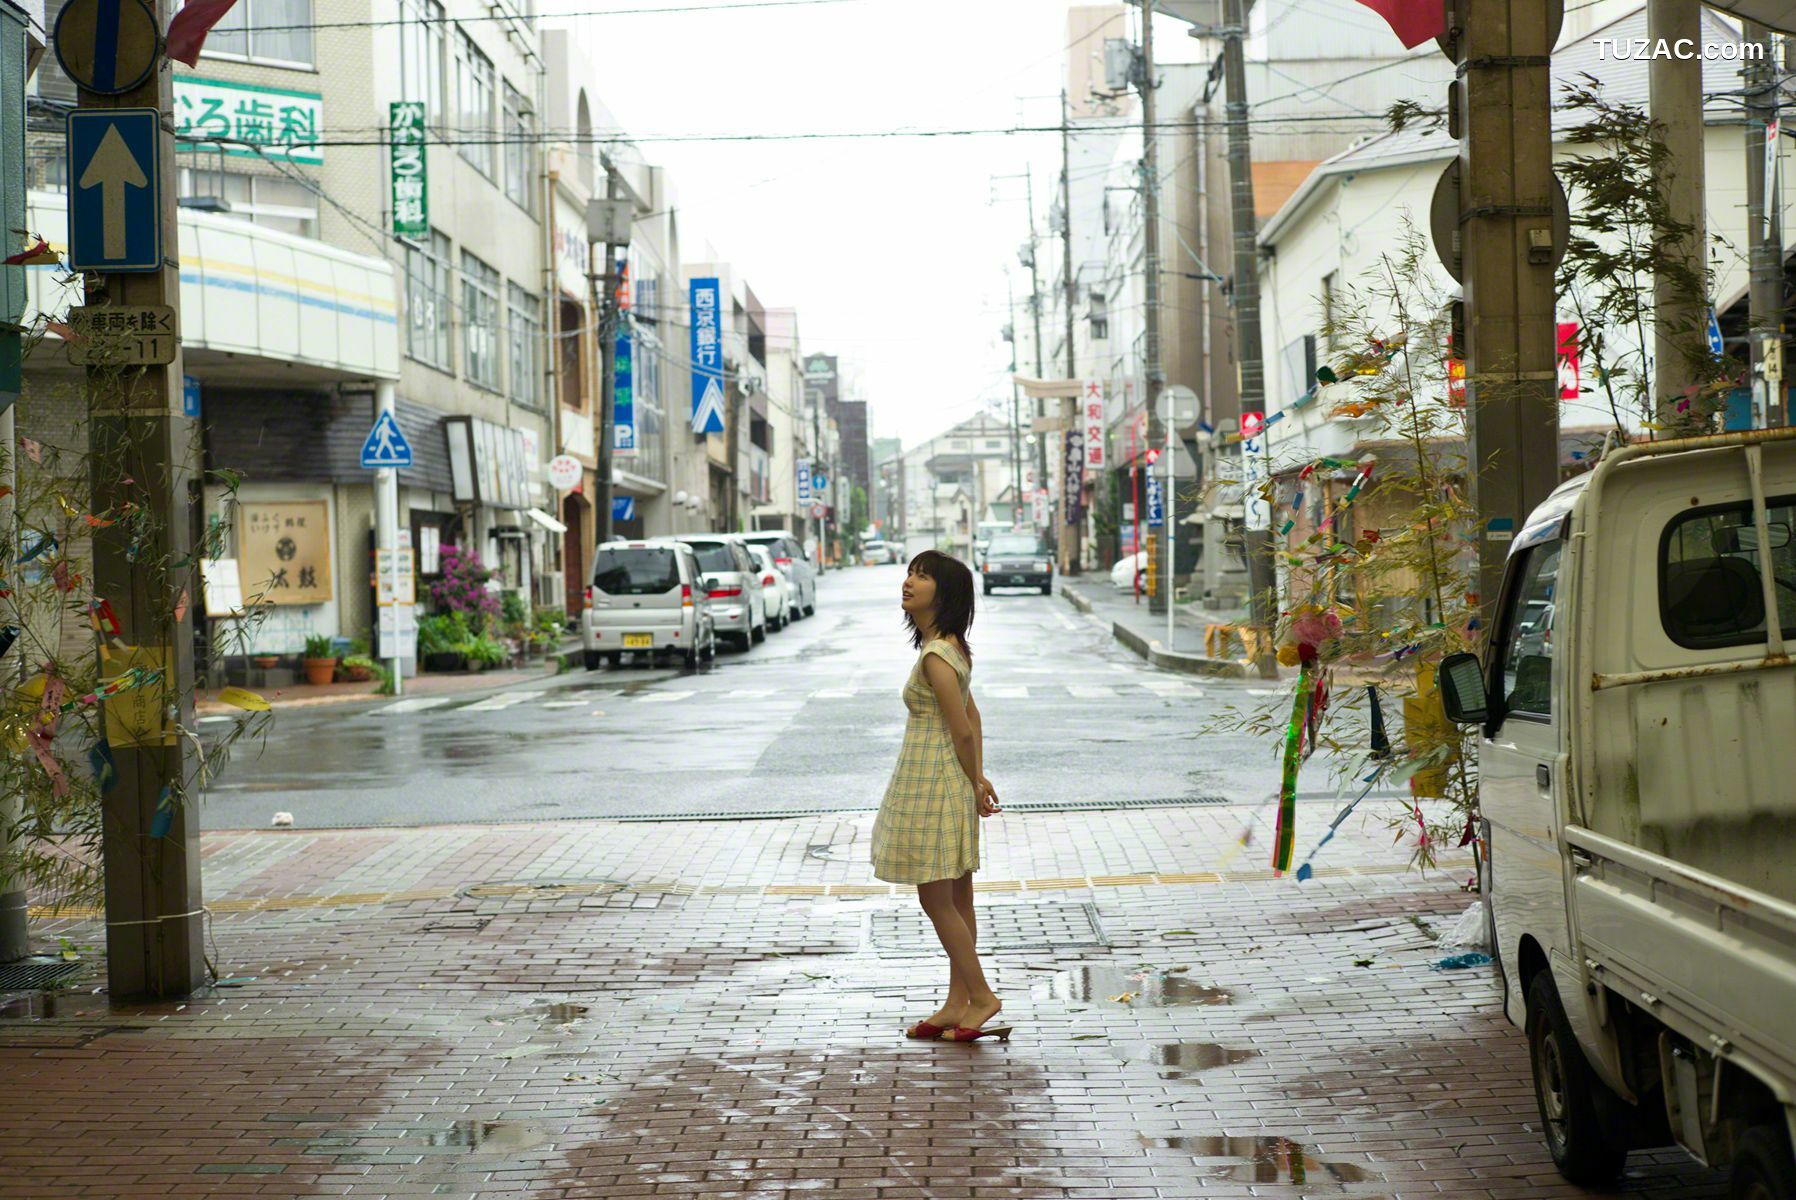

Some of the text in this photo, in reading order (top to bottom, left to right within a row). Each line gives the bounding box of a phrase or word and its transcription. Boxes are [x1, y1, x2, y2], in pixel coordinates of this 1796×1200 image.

[73, 311, 170, 332] 車両を除く
[695, 288, 716, 366] 西京銀行
[1087, 381, 1103, 464] 大和交通
